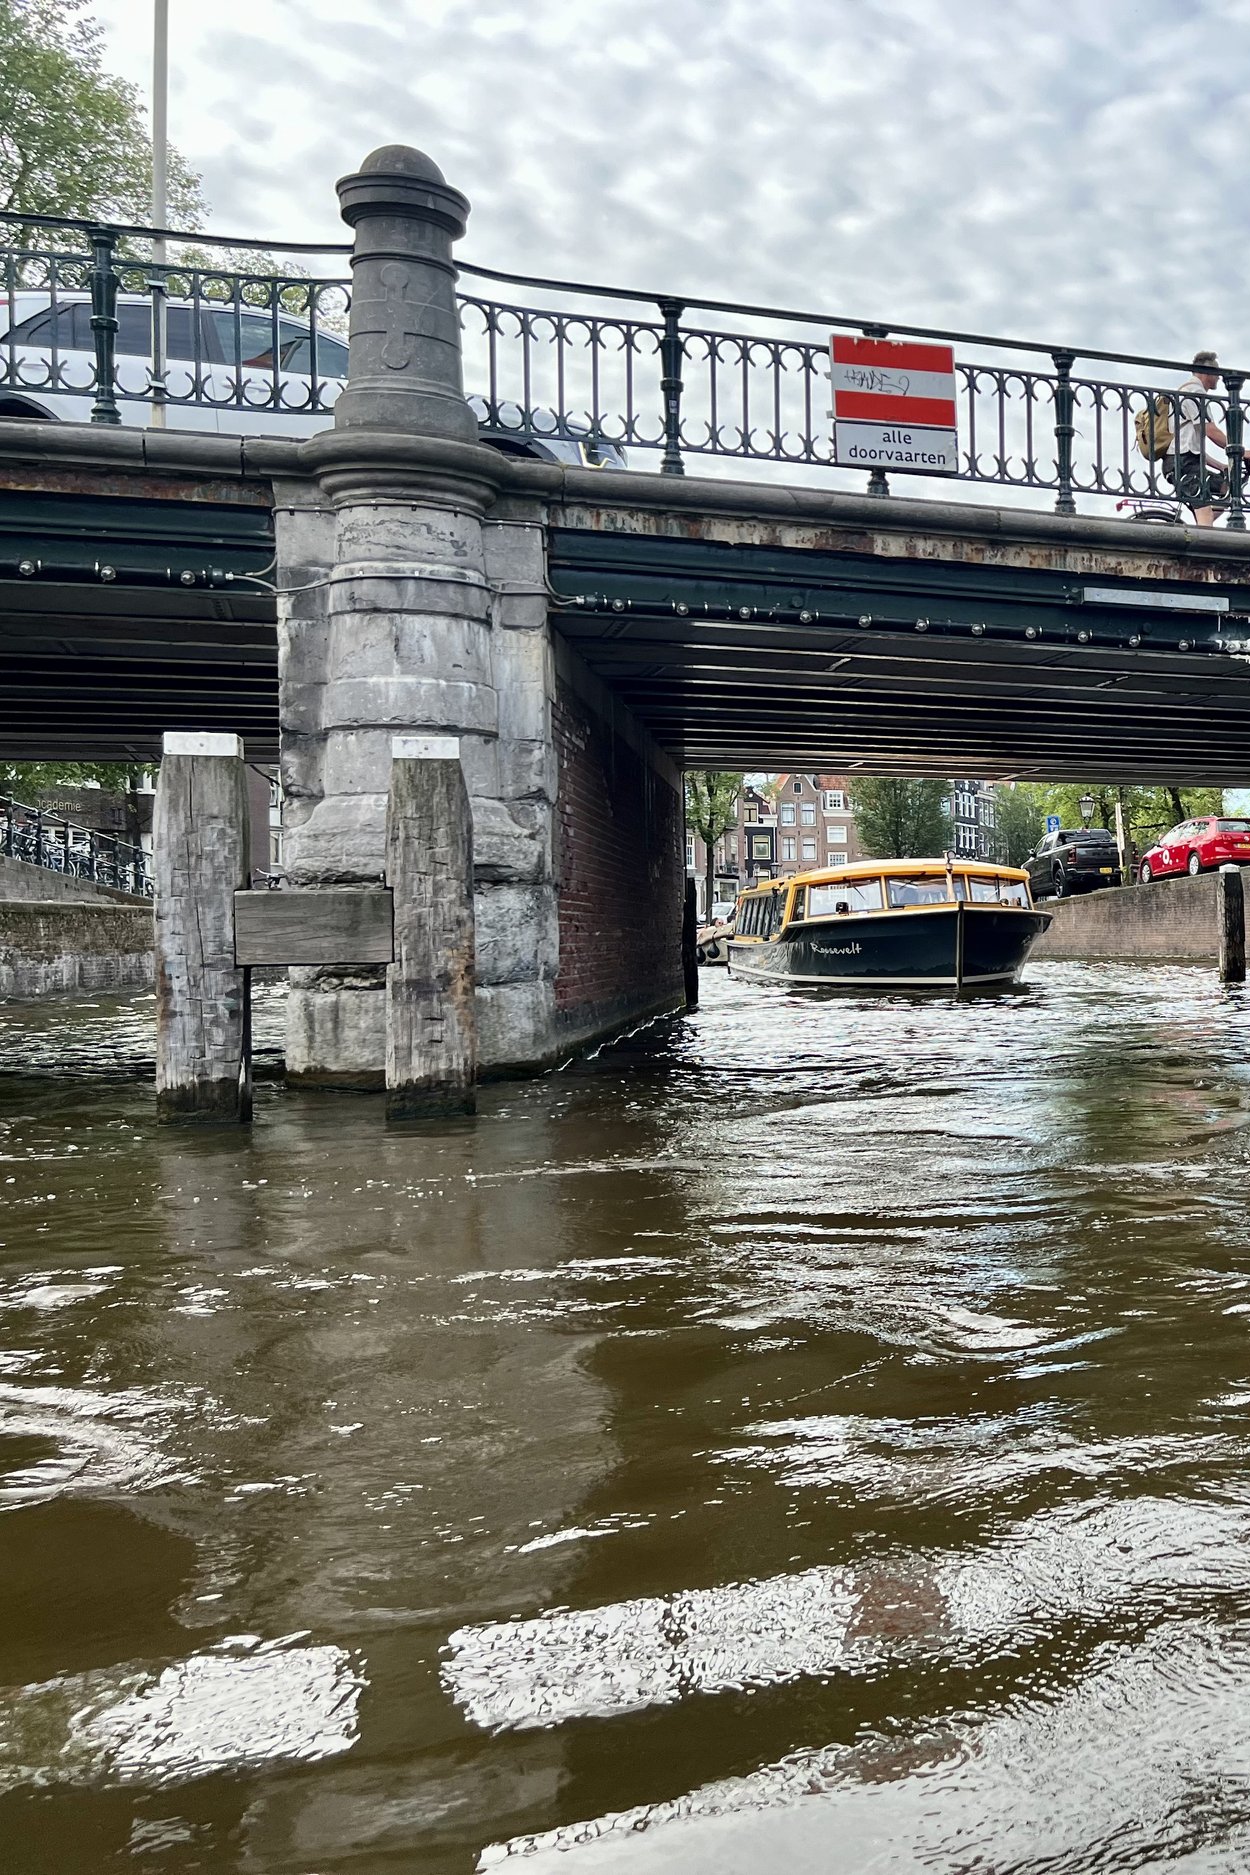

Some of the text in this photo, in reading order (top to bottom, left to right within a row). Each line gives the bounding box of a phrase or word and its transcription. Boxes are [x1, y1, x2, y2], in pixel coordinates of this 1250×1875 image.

[882, 430, 912, 444] alle
[849, 444, 946, 465] doorvaarten
[809, 941, 863, 955] Roosevelt
